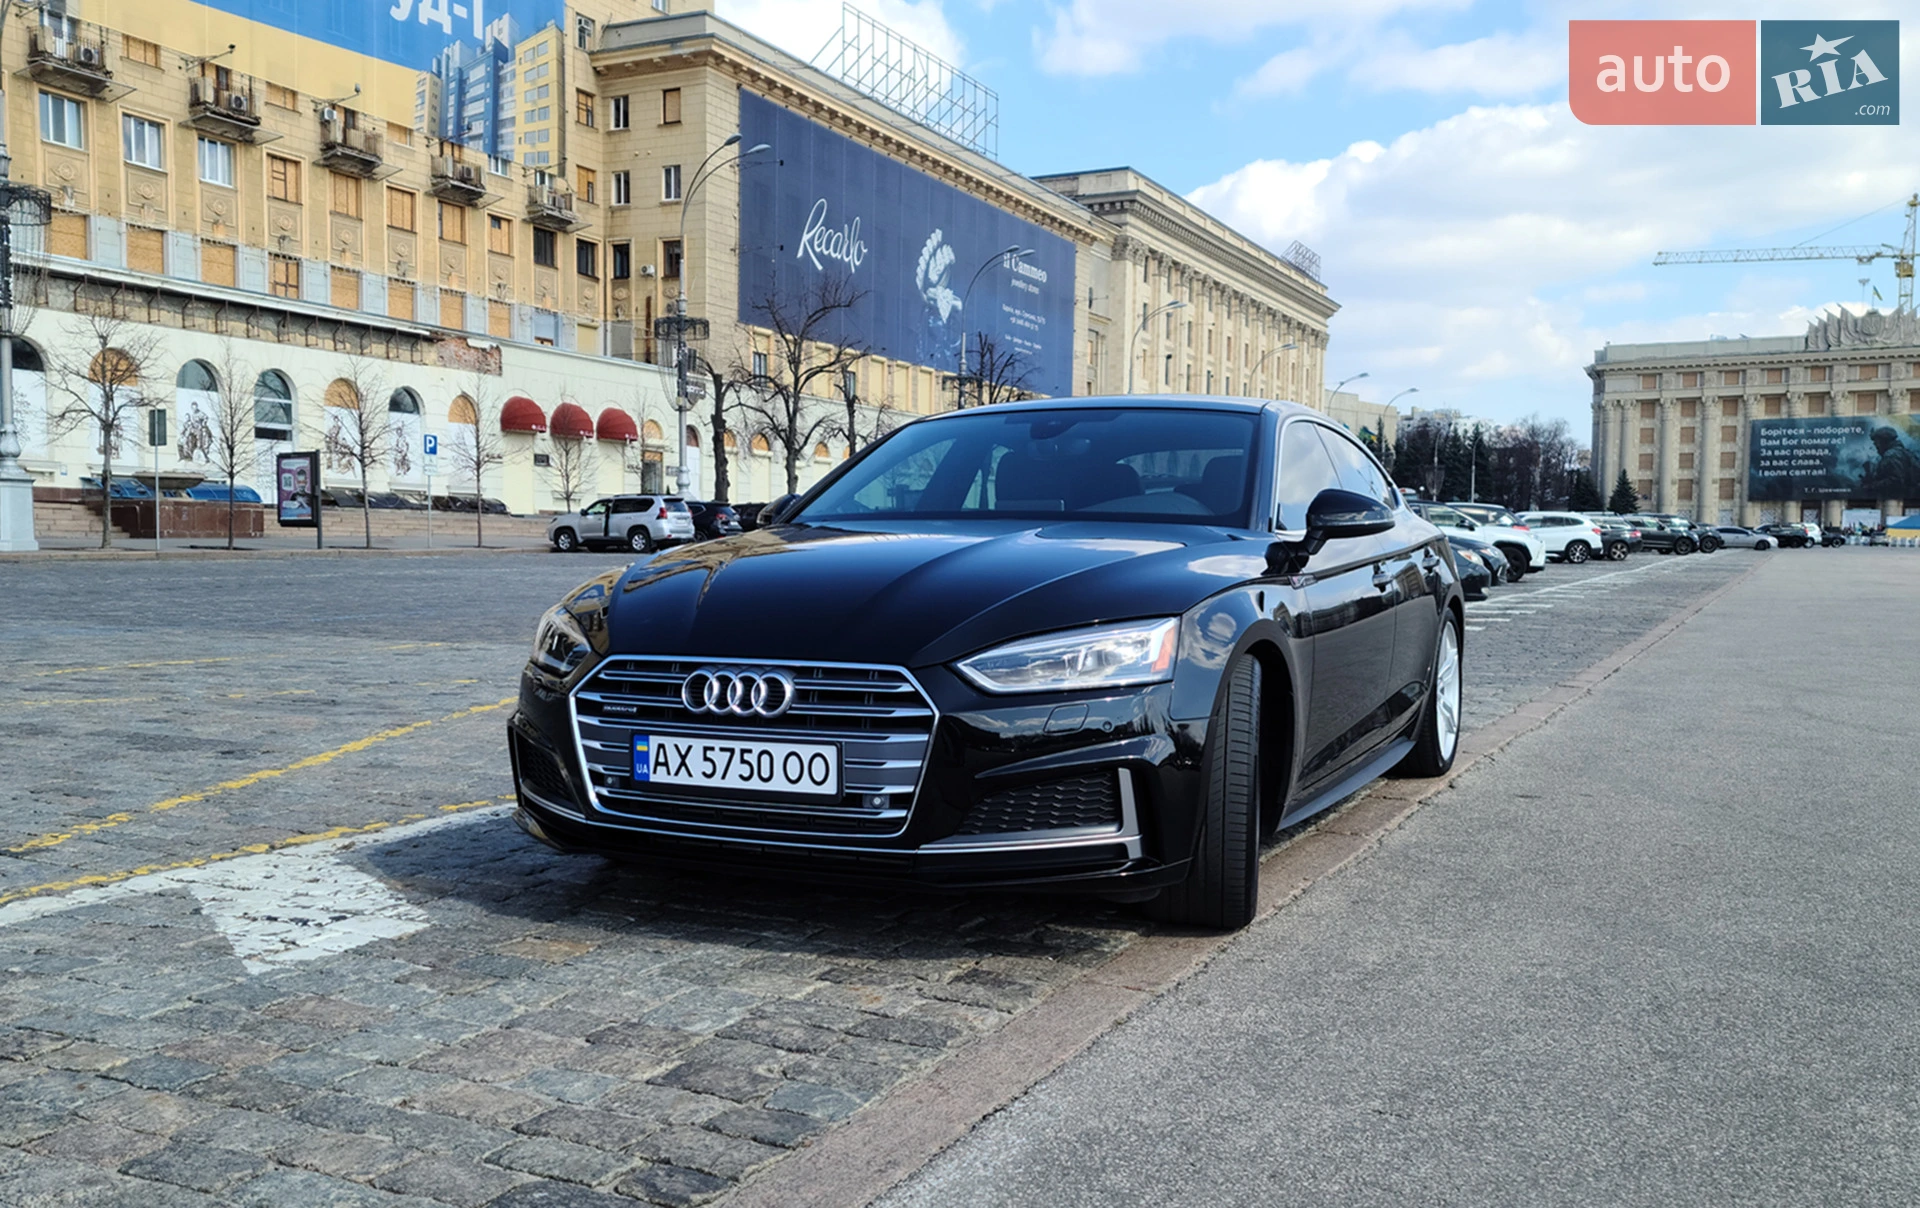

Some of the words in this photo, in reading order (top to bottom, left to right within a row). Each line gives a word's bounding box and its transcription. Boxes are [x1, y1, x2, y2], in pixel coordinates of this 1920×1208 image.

[796, 198, 868, 274] Recarlo
[1761, 427, 1805, 437] Борітеся
[1813, 426, 1865, 435] поборете,
[1760, 438, 1780, 446] Вам
[1782, 438, 1798, 446] Бог
[1760, 448, 1772, 456] За
[1793, 448, 1832, 457] правда,
[636, 763, 649, 774] UA
[652, 743, 693, 778] AX
[701, 746, 774, 783] 5750
